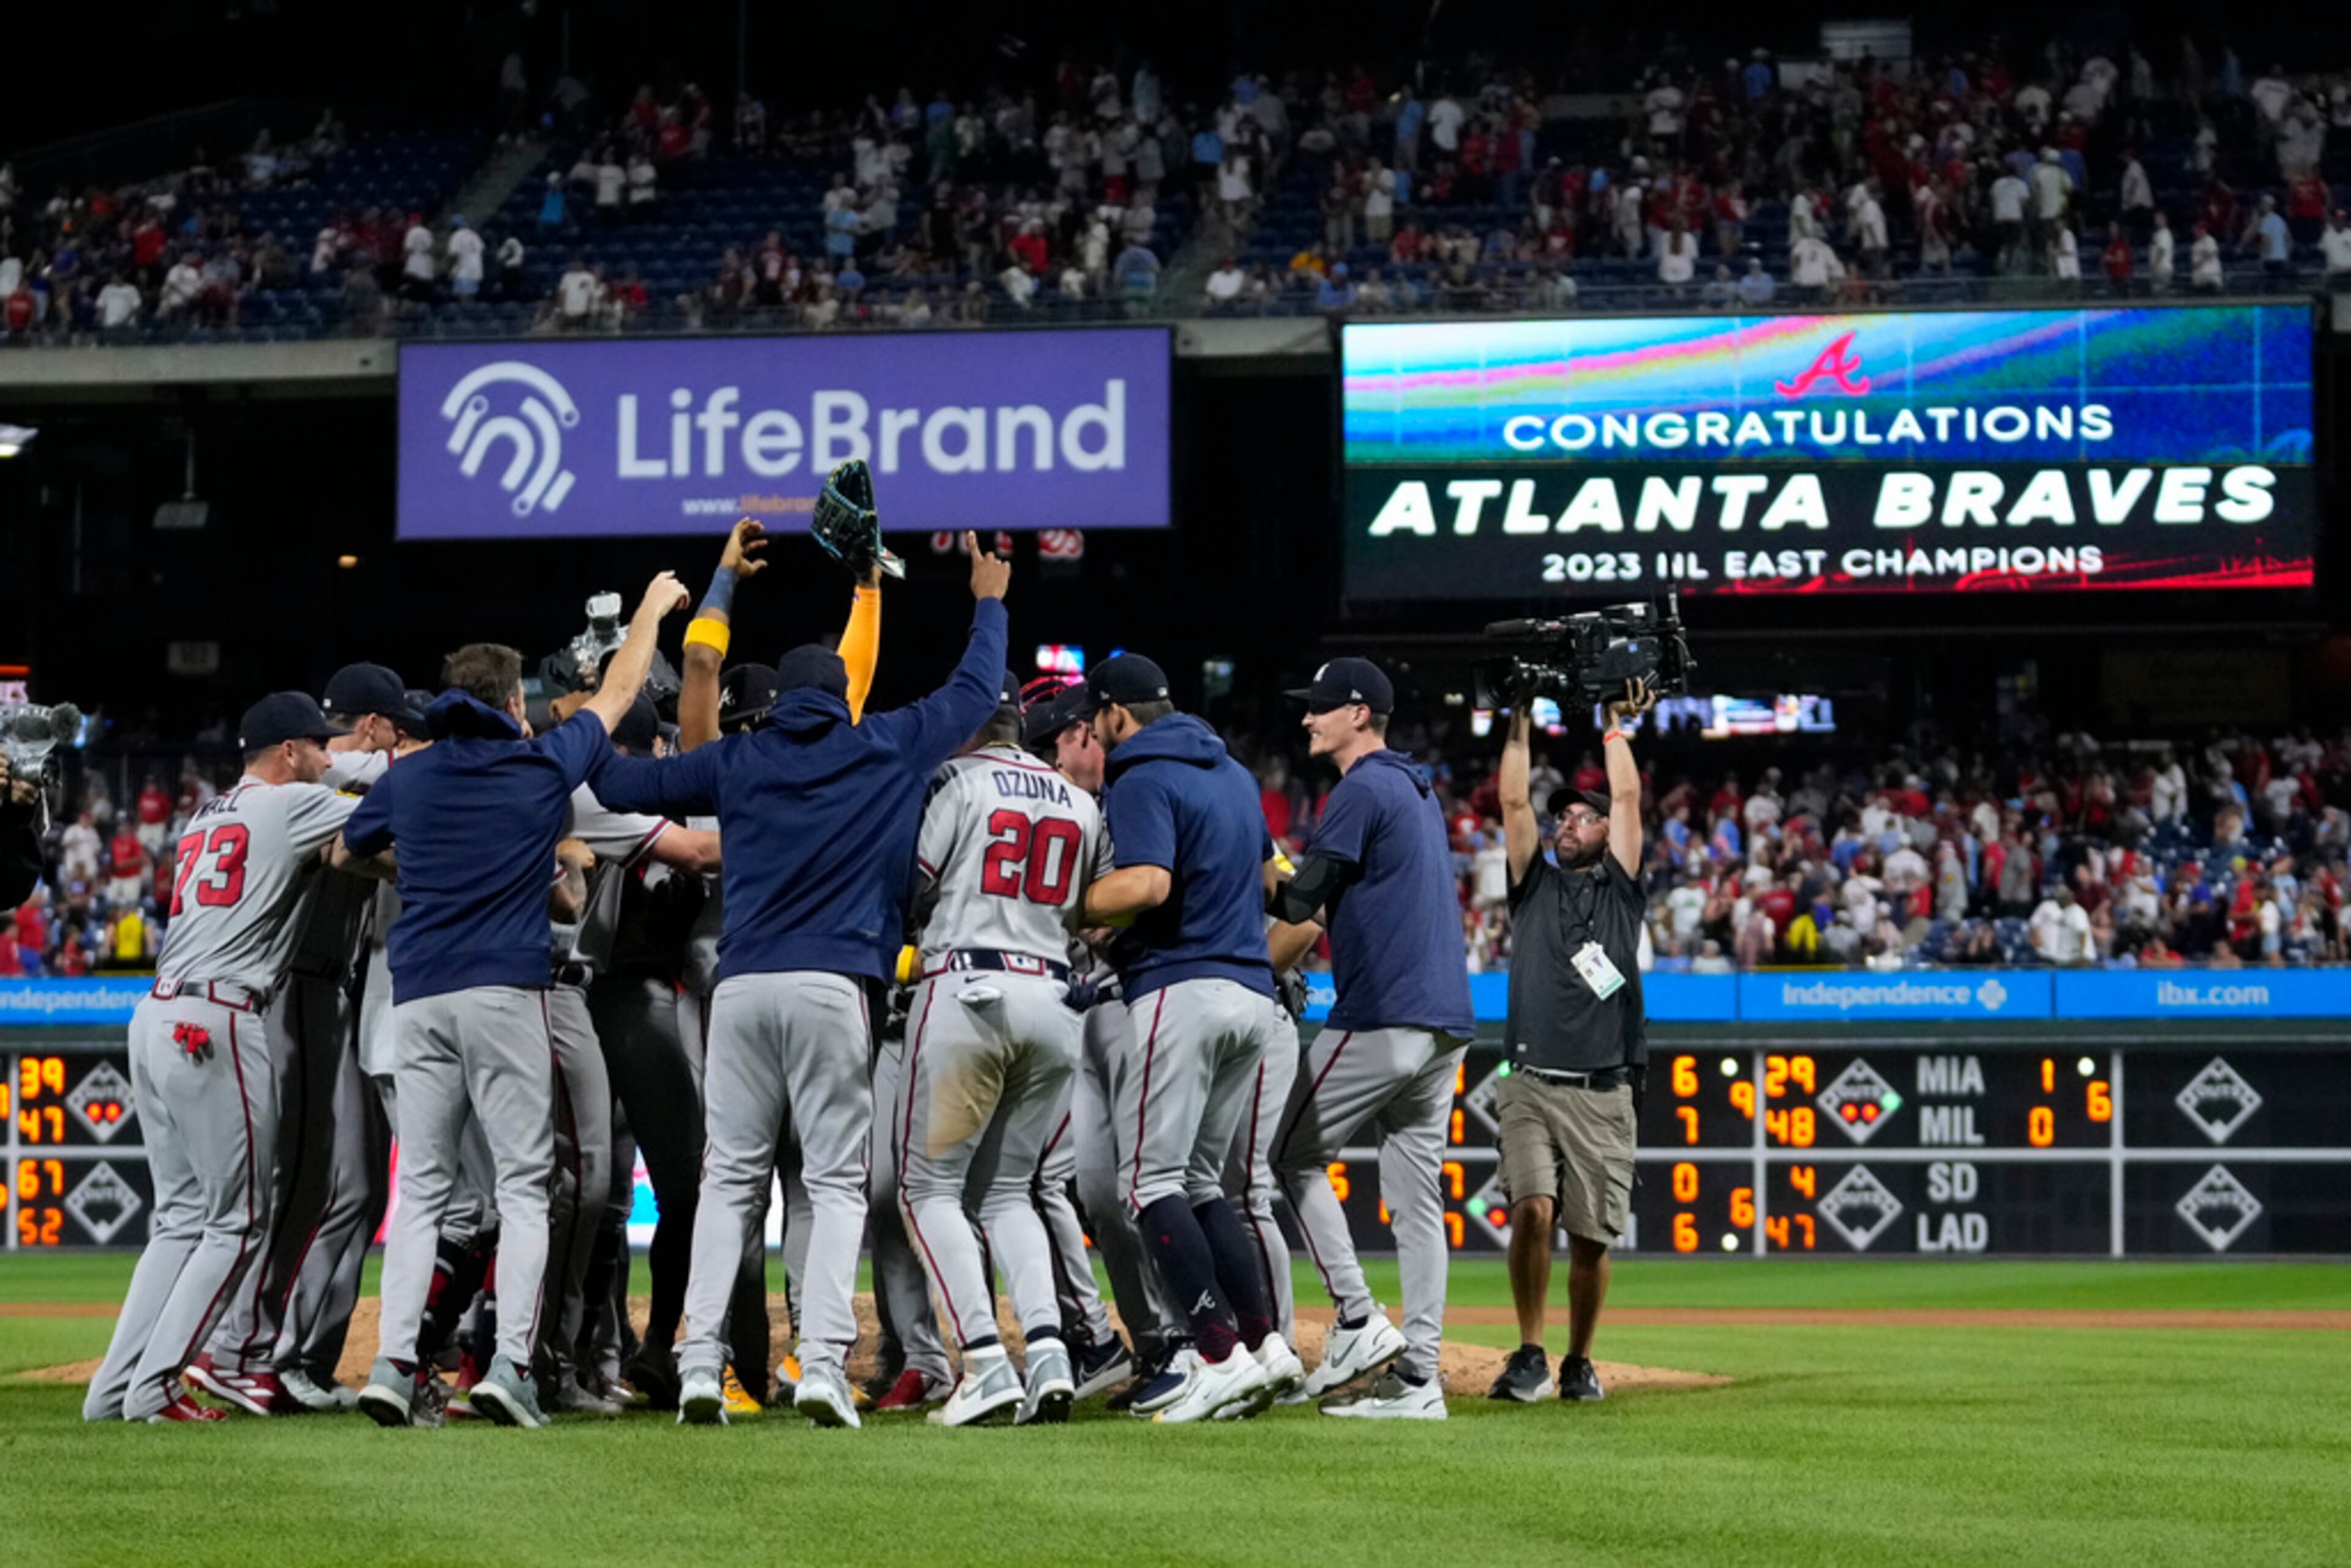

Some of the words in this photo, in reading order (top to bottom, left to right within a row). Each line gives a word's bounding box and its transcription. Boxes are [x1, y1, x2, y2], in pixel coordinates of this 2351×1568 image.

[618, 379, 1126, 478] LifeBrand
[1504, 404, 2113, 451] CONGRATULATIONS
[1368, 474, 1829, 535] ATLANTA
[1873, 465, 2276, 528] BRAVES
[1542, 552, 1643, 582] 2023
[1724, 549, 1827, 579] EAST
[1841, 544, 2104, 577] CHAMPIONS
[991, 770, 1073, 809] OZUNA
[170, 822, 250, 917] 73
[981, 809, 1082, 905] 20
[1782, 980, 1971, 1010] Independence
[2157, 981, 2270, 1005] ibx.com
[20, 1057, 65, 1098] 39
[1672, 1055, 1698, 1097] 6
[1765, 1055, 1816, 1097] 29
[1916, 1056, 1985, 1095] MIA
[2041, 1057, 2055, 1093] 1
[1729, 1081, 1755, 1119] 9
[2087, 1080, 2113, 1122] 6
[18, 1106, 64, 1144] 47
[1676, 1105, 1699, 1145] 7
[1764, 1106, 1816, 1147] 48
[1919, 1106, 1985, 1145] MIL
[2028, 1106, 2054, 1147] 0
[17, 1158, 64, 1199] 67
[1672, 1161, 1699, 1202] 0
[1790, 1165, 1816, 1200] 4
[1927, 1161, 1978, 1202] SD
[17, 1207, 63, 1245] 52
[1730, 1187, 1756, 1228] 6
[1673, 1212, 1699, 1252] 6
[1765, 1213, 1816, 1250] 47
[1917, 1212, 1987, 1251] LAD
